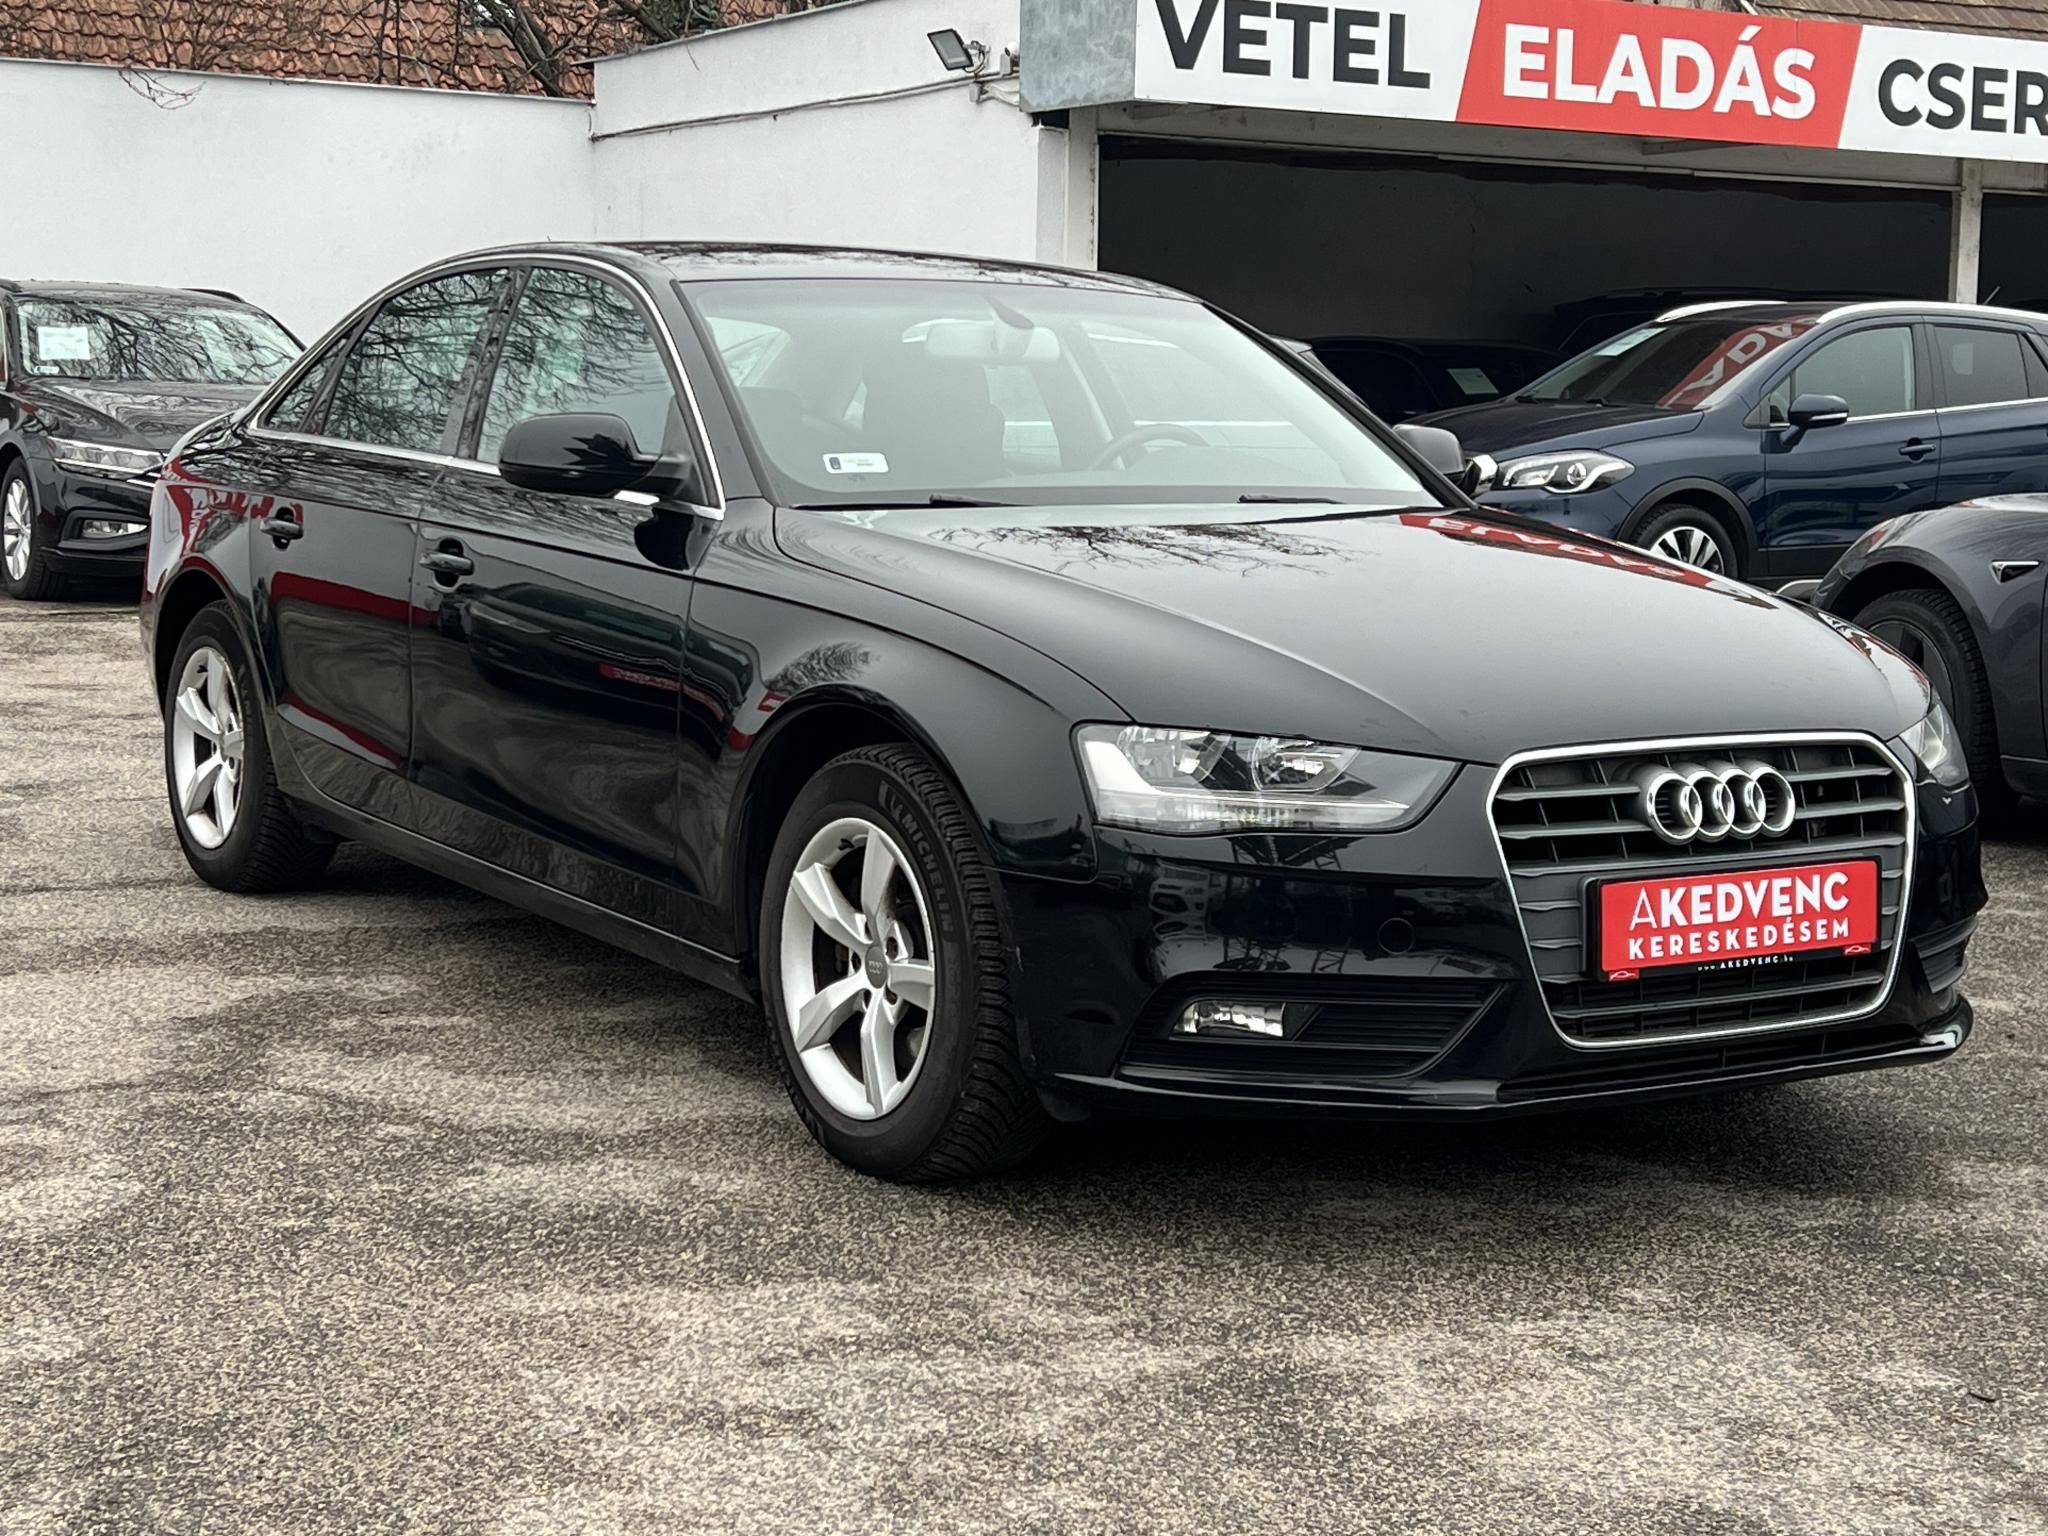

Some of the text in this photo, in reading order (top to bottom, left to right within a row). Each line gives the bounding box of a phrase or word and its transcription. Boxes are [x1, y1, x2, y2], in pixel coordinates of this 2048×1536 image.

[1503, 23, 1817, 120] ELADÁS
[1878, 58, 2048, 136] CSER
[902, 812, 954, 932] MICHELIN
[1629, 913, 1850, 960] KERESKEDÉSEM
